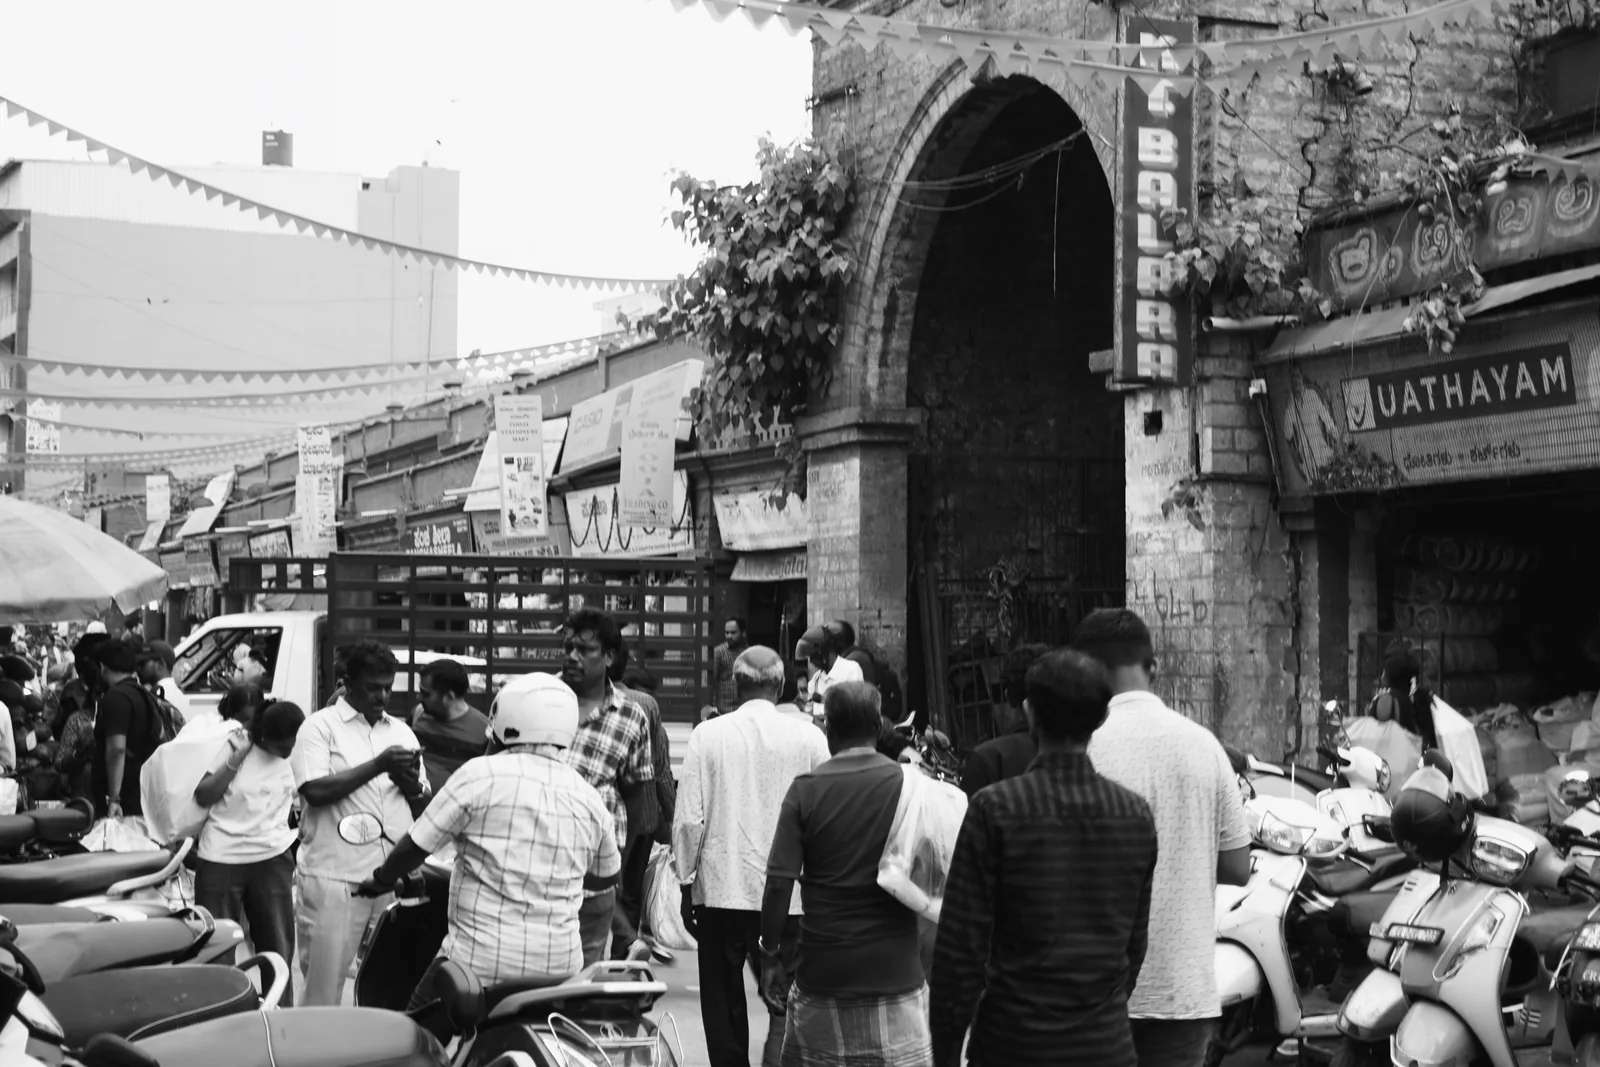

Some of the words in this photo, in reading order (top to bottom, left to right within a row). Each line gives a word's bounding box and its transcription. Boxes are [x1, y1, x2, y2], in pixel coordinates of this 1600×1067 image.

[1376, 355, 1568, 418] UATHAYAM
[574, 408, 604, 434] CASIO
[624, 499, 656, 510] TRADING
